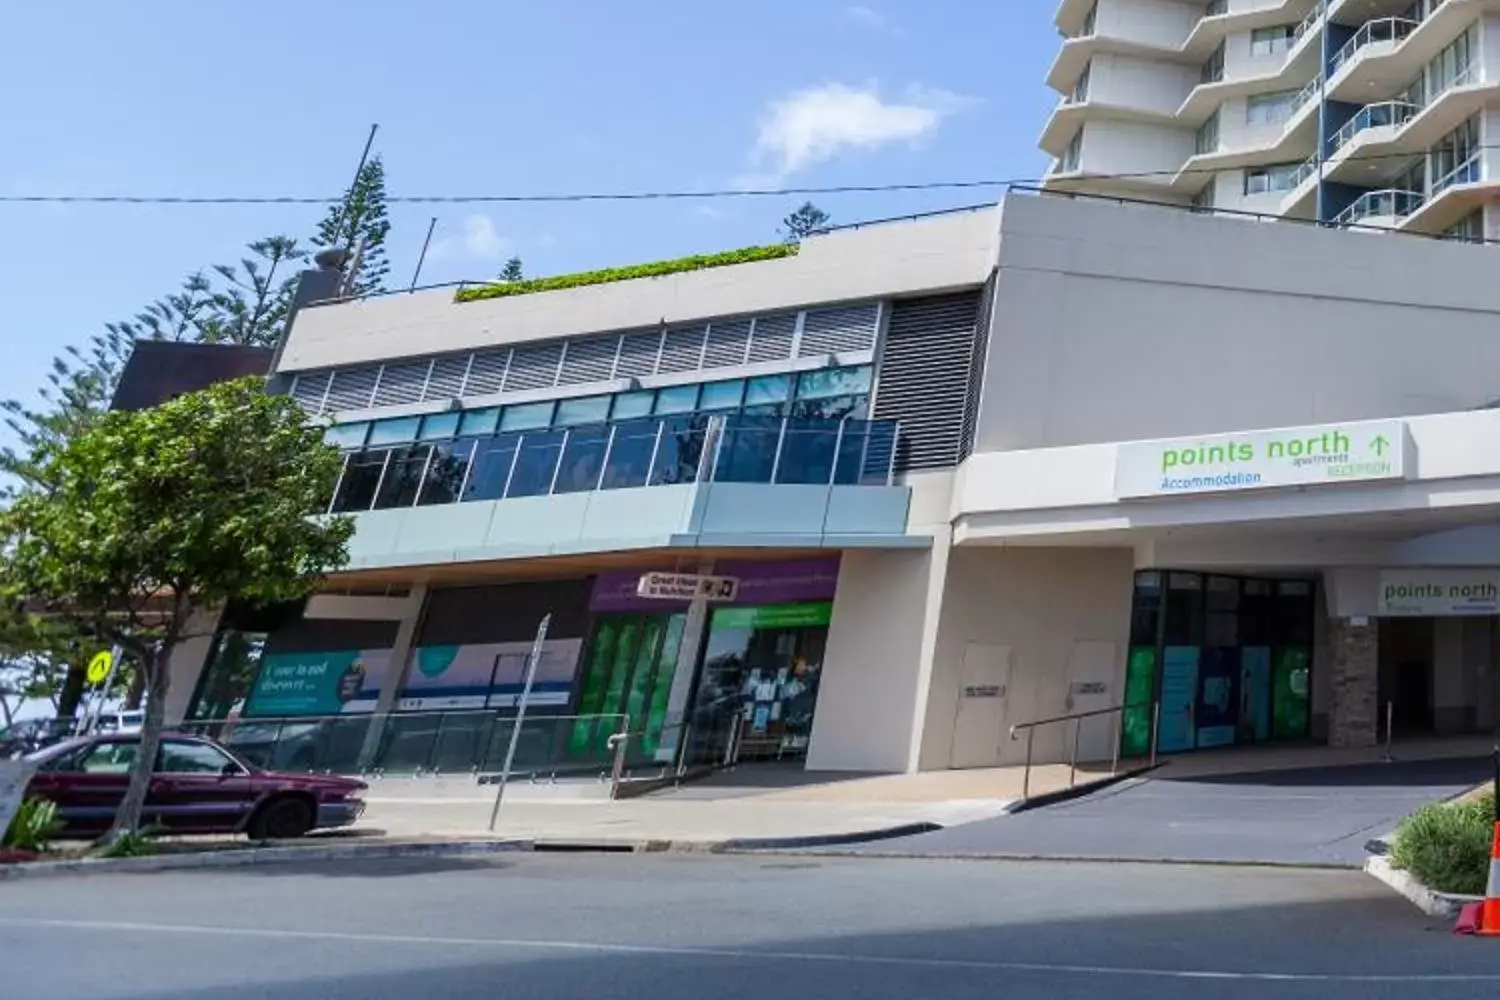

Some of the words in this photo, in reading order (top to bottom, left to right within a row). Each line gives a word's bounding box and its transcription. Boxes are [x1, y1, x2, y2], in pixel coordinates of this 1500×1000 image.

[1162, 440, 1254, 474] points
[1267, 430, 1350, 459] north
[1293, 453, 1348, 468] apartments
[1327, 461, 1391, 477] RECEPTION
[1161, 472, 1262, 490] Accommodation
[1385, 582, 1443, 600] points
[1449, 581, 1497, 598] north
